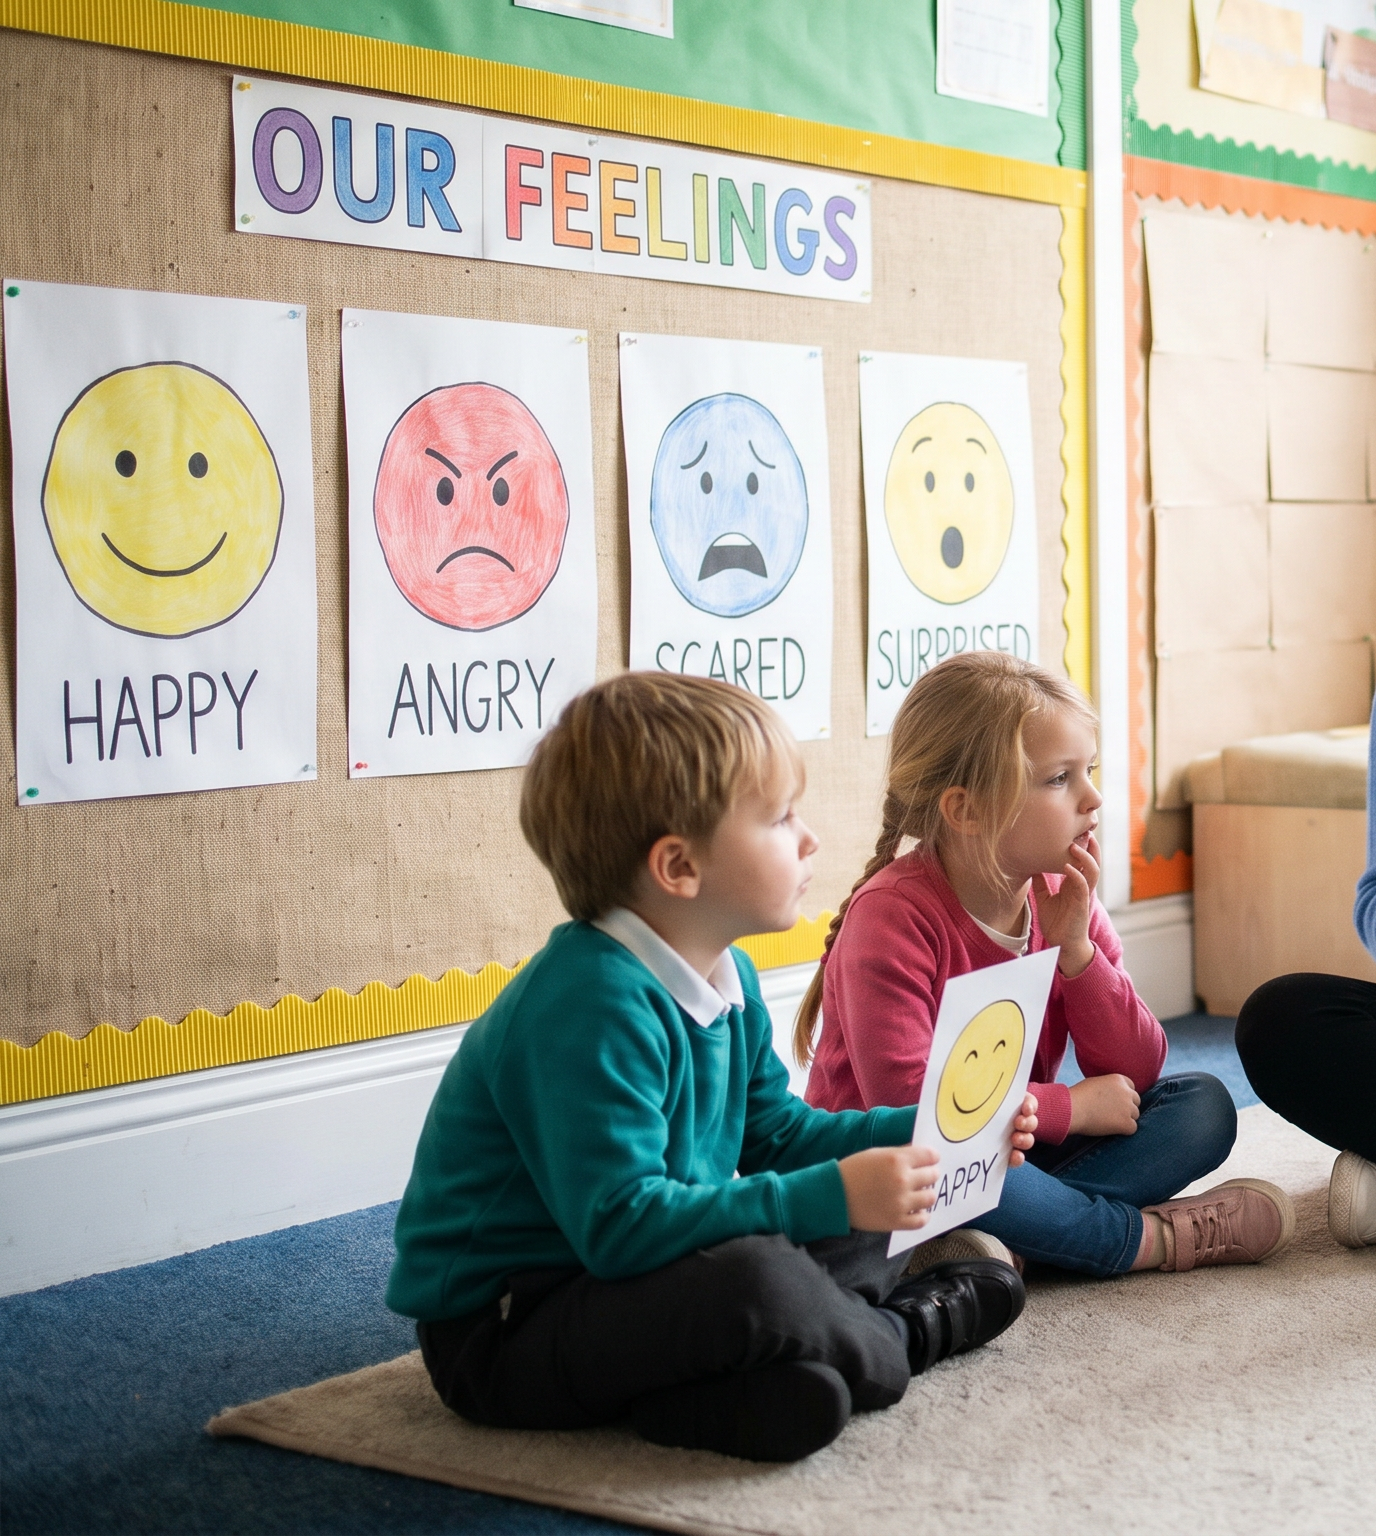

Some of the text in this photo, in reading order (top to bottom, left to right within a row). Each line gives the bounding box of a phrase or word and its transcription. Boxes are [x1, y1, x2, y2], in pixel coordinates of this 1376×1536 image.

[252, 107, 859, 282] OUR FEELINGS
[63, 669, 259, 765] HAPPY
[387, 657, 556, 739] ANGRY
[926, 1152, 999, 1213] APPY
